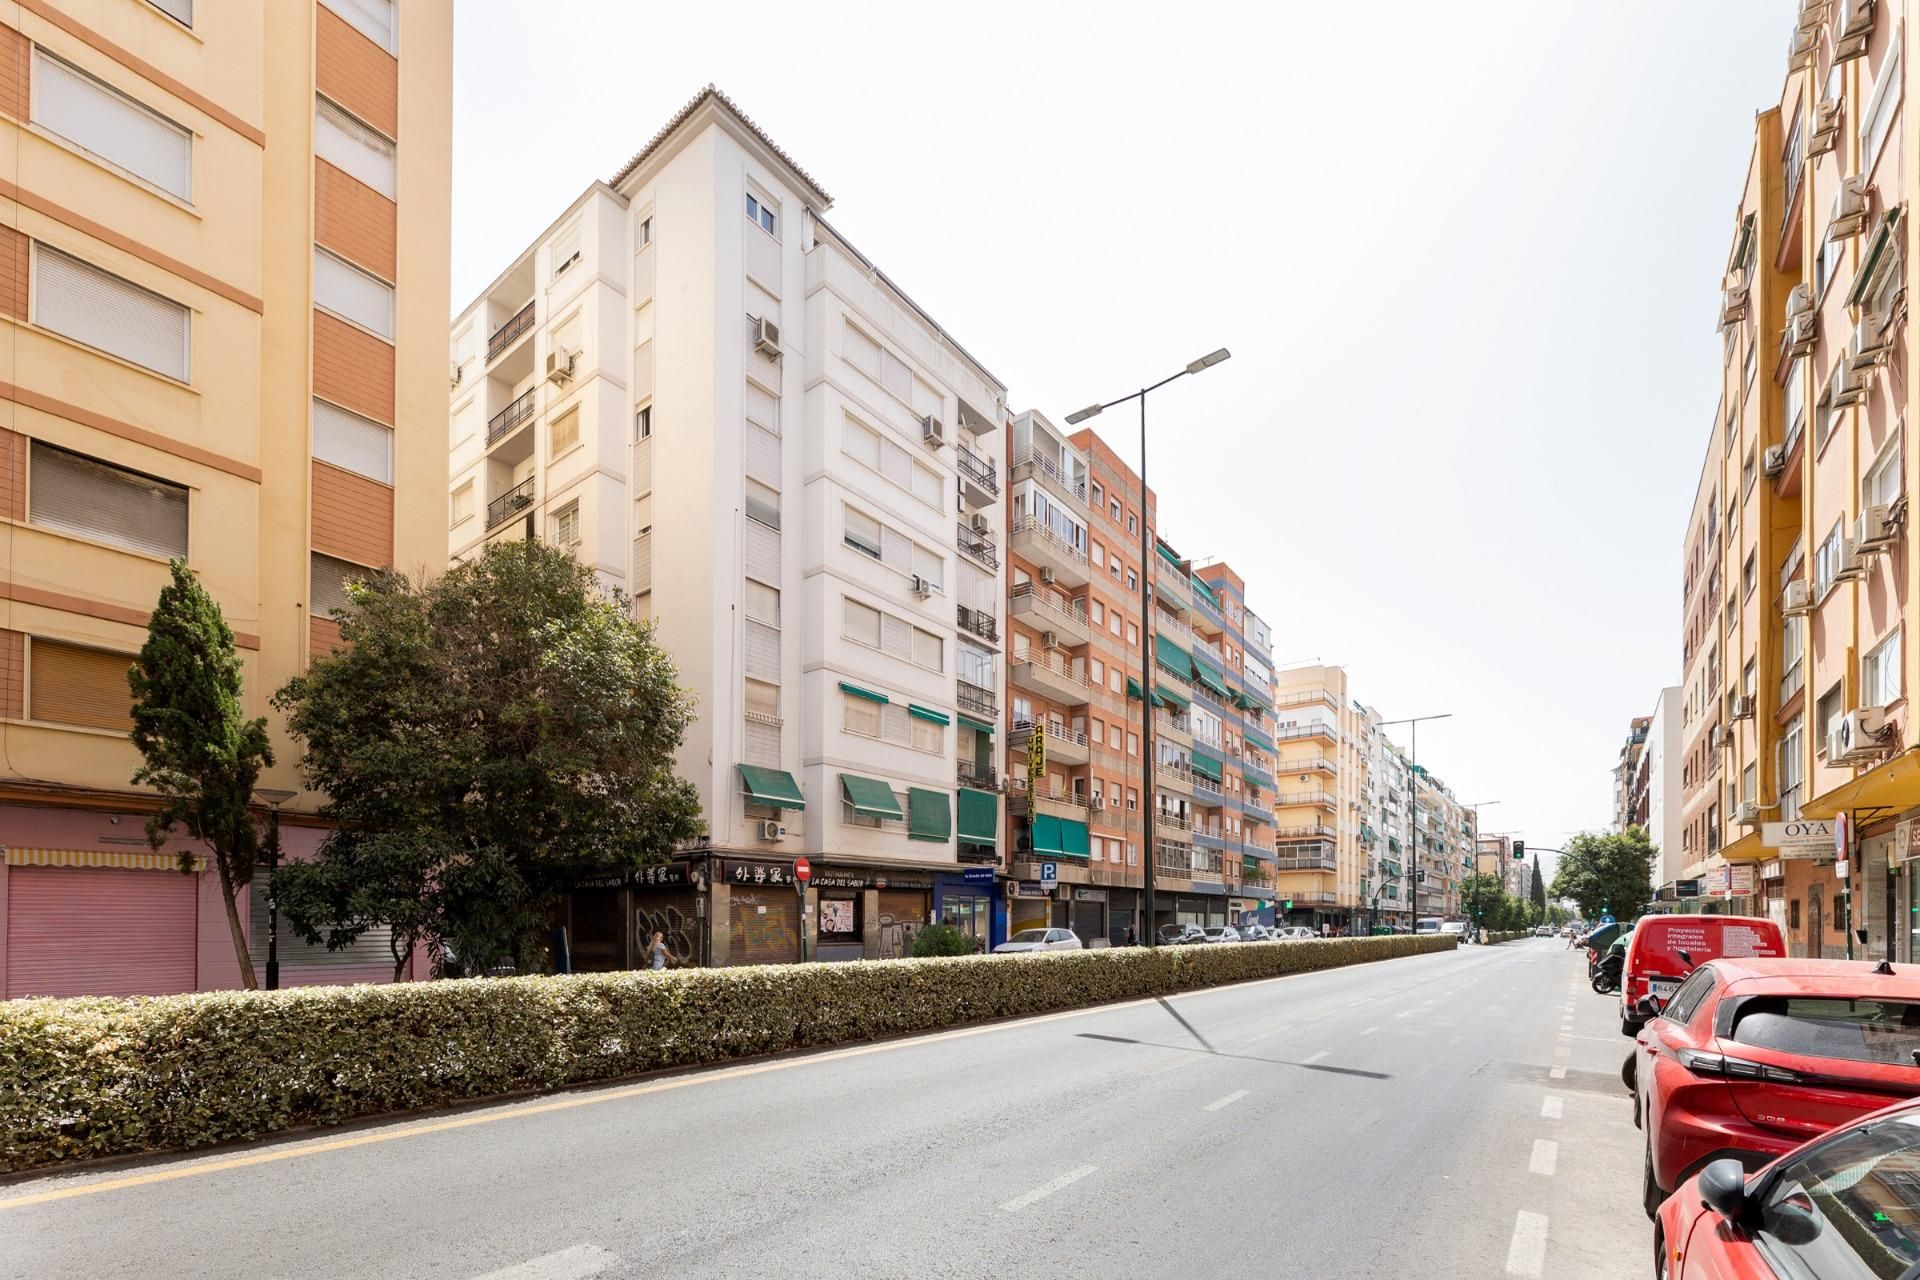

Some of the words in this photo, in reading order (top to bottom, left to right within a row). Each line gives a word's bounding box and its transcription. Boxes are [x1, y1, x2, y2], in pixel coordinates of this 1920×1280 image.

[1035, 725, 1043, 776] ARAJE
[1785, 822, 1829, 836] OYA
[1044, 864, 1053, 879] P
[575, 880, 582, 888] LA
[582, 880, 595, 888] CASA
[595, 879, 606, 888] DEL
[606, 878, 622, 887] SABOR
[811, 878, 819, 886] LA
[820, 878, 835, 887] CASA
[836, 879, 846, 887] DEL
[847, 879, 864, 888] SABOR
